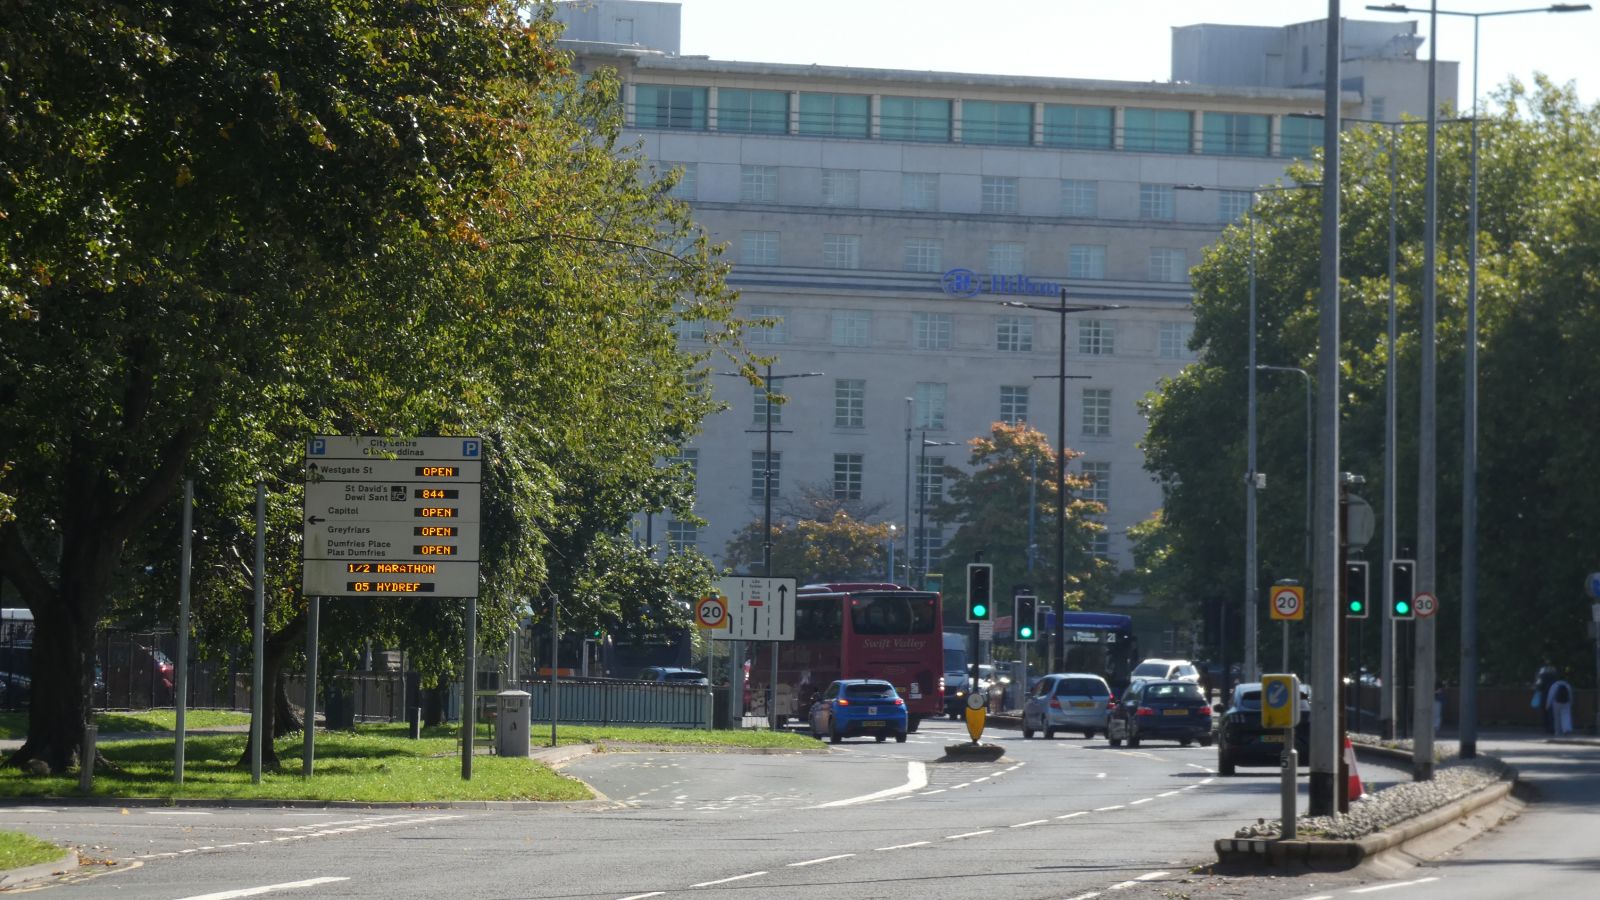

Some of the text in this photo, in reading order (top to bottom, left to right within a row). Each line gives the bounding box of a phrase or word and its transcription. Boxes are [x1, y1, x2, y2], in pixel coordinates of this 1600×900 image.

[991, 274, 1058, 296] Hilton
[370, 440, 387, 448] City
[320, 466, 373, 474] Westgate St
[423, 467, 453, 476] OPEN
[423, 489, 444, 498] 844
[328, 507, 359, 515] Capitol
[422, 508, 451, 517] OPEN
[328, 526, 370, 534] Greyfriars
[421, 527, 451, 536] OPEN
[368, 540, 391, 548] Place
[327, 548, 345, 556] Plas
[421, 546, 451, 555] OPEN
[349, 564, 436, 573] 1/2 MARATHON
[376, 582, 421, 592] HYDREF
[1278, 596, 1297, 609] 20
[1416, 599, 1433, 610] 30
[702, 606, 721, 618] 20
[863, 639, 926, 650] Swift Valley
